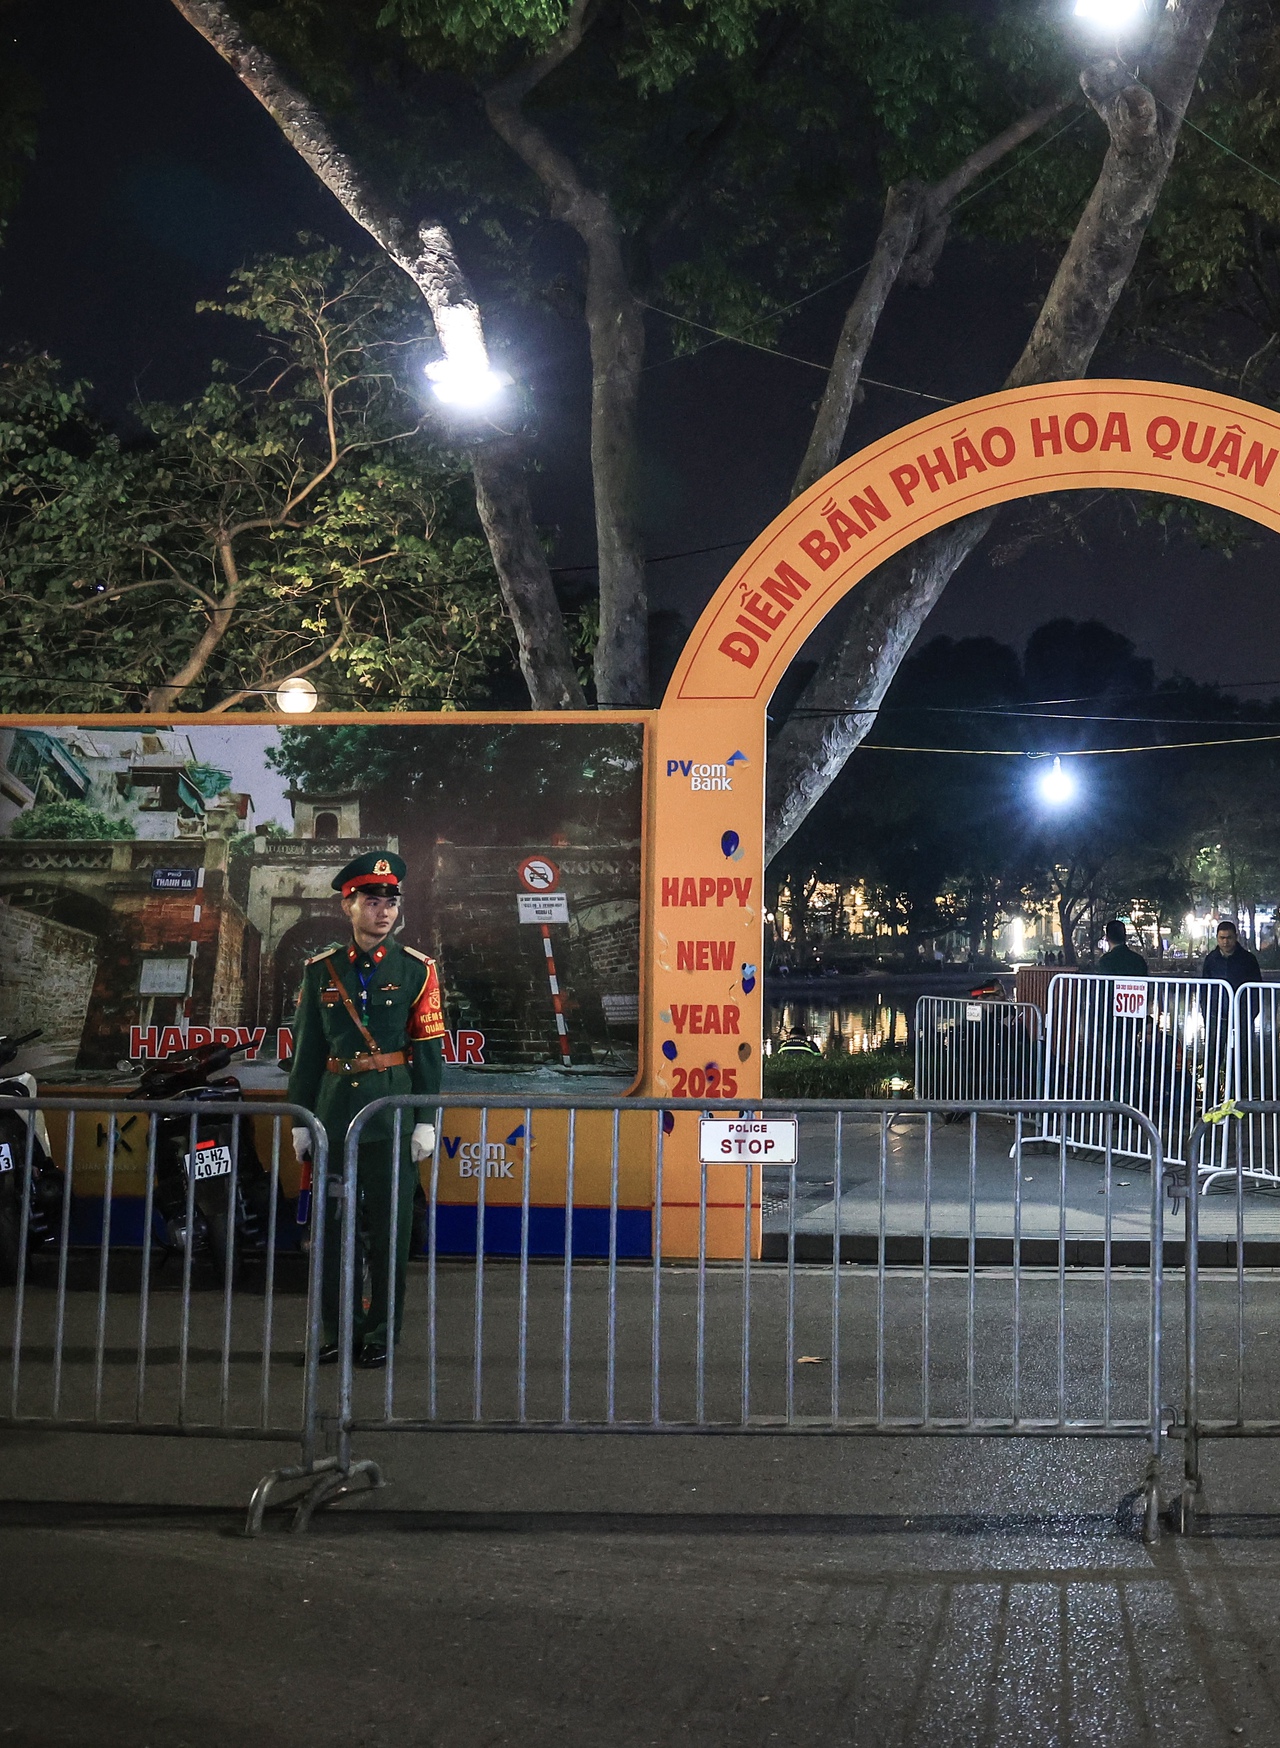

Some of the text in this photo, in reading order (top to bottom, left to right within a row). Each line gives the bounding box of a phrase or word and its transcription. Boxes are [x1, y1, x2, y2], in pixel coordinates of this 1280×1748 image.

[718, 560, 812, 669] ĐIỂM
[799, 485, 892, 572] BẮN
[889, 426, 1016, 507] PHÁO
[1030, 411, 1132, 458] HOA
[1146, 415, 1280, 488] QUẬN
[666, 759, 727, 777] PVcom
[691, 777, 732, 791] Bank
[661, 877, 753, 907] HAPPY
[677, 940, 736, 971] NEW
[1116, 992, 1144, 1014] STOP
[670, 1004, 741, 1035] YEAR
[130, 1026, 266, 1060] HAPPY
[441, 1029, 485, 1064] AR
[671, 1067, 739, 1099] 2025
[728, 1124, 768, 1133] POLICE
[195, 1148, 225, 1165] 9-H2
[441, 1136, 506, 1160] Vcom
[720, 1139, 776, 1155] STOP
